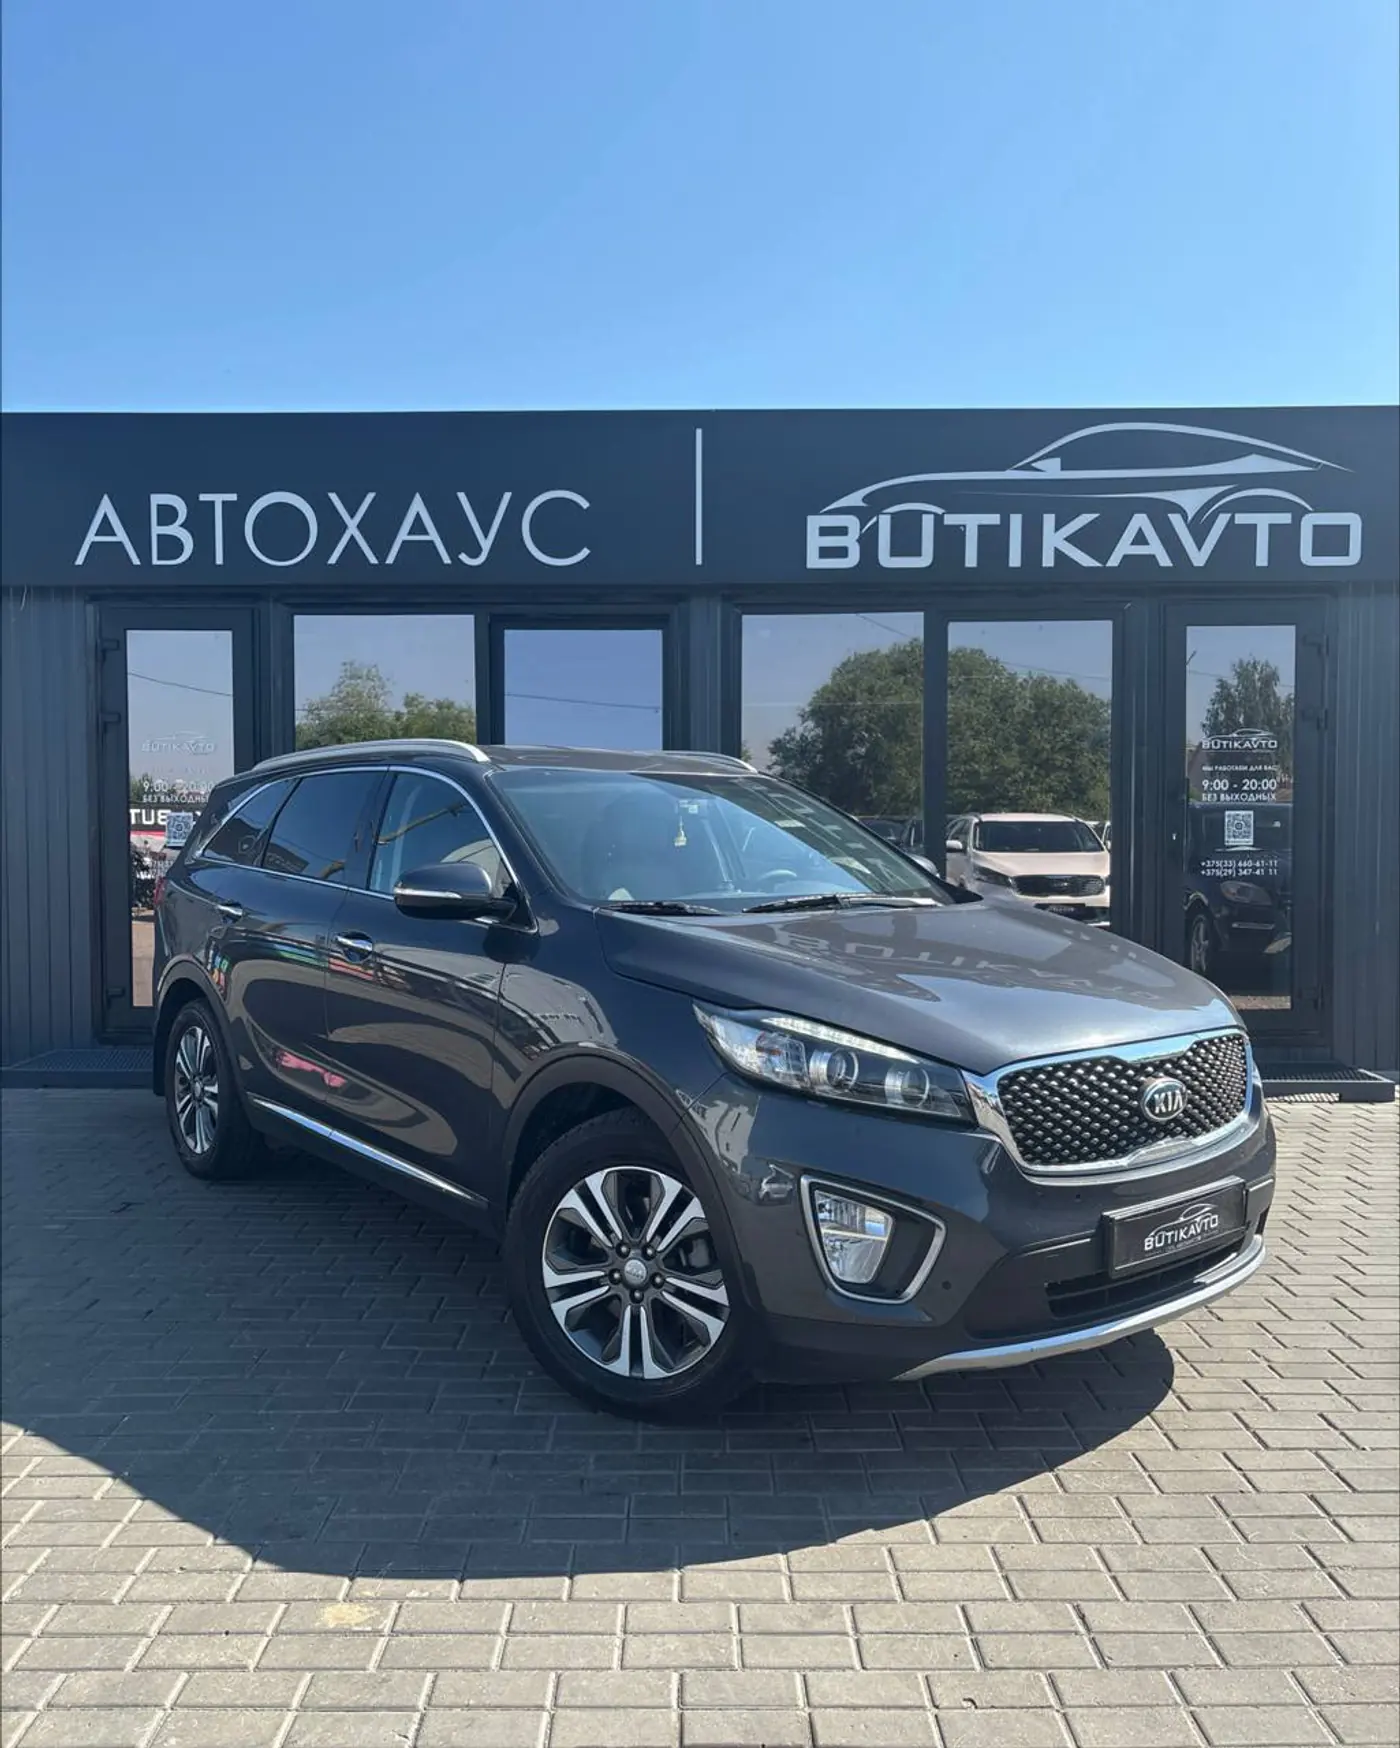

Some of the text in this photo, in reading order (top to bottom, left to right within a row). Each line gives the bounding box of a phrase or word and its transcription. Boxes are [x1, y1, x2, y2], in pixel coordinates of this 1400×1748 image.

[74, 490, 591, 567] АВТОХАУС
[805, 511, 1362, 570] BUTIKAVTO
[1201, 739, 1278, 750] BUTIKAVTO
[1201, 779, 1229, 790] 9:00
[1241, 779, 1277, 790] 20:00
[160, 794, 208, 803] ВЫХОДНЫ
[1202, 793, 1277, 802] БЕЗ ВЫХОДНЫХ
[1153, 1090, 1183, 1114] KIA
[1144, 1215, 1219, 1251] BUTIKAVTO
